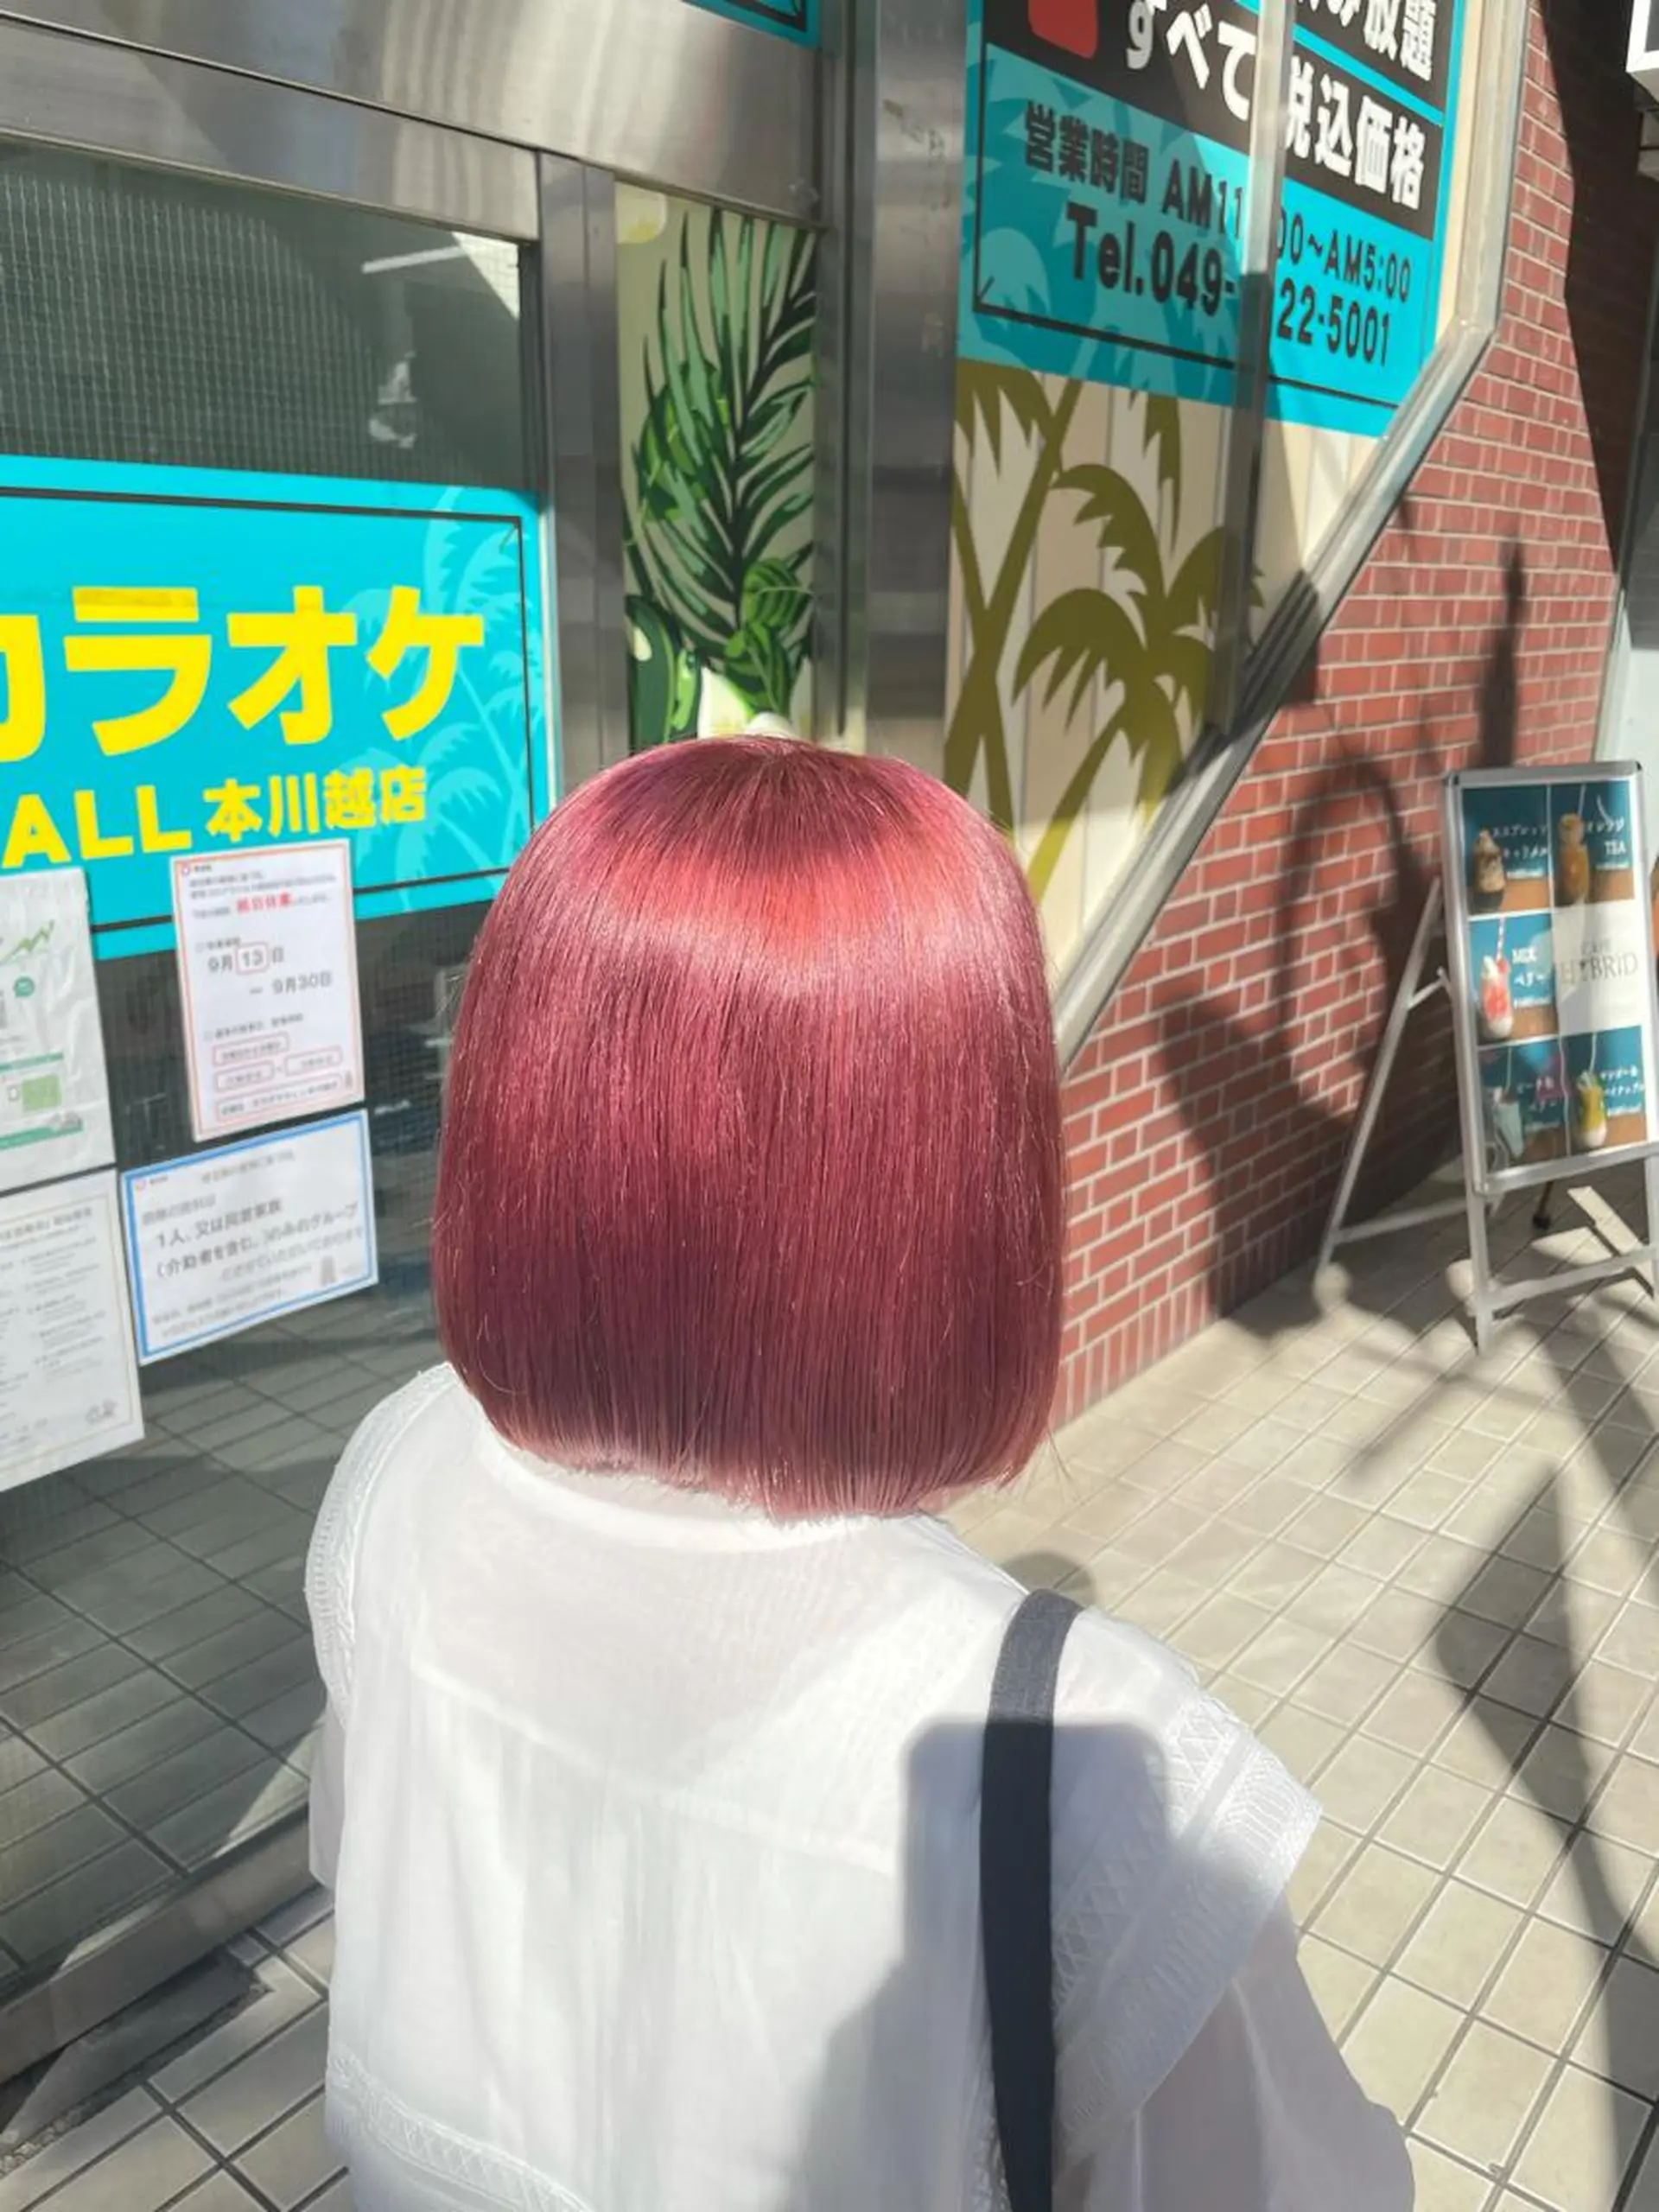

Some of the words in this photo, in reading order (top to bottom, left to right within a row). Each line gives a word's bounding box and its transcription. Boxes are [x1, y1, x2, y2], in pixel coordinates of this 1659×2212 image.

[1025, 99, 1149, 205] 営業時間
[203, 766, 428, 843] 本川越店
